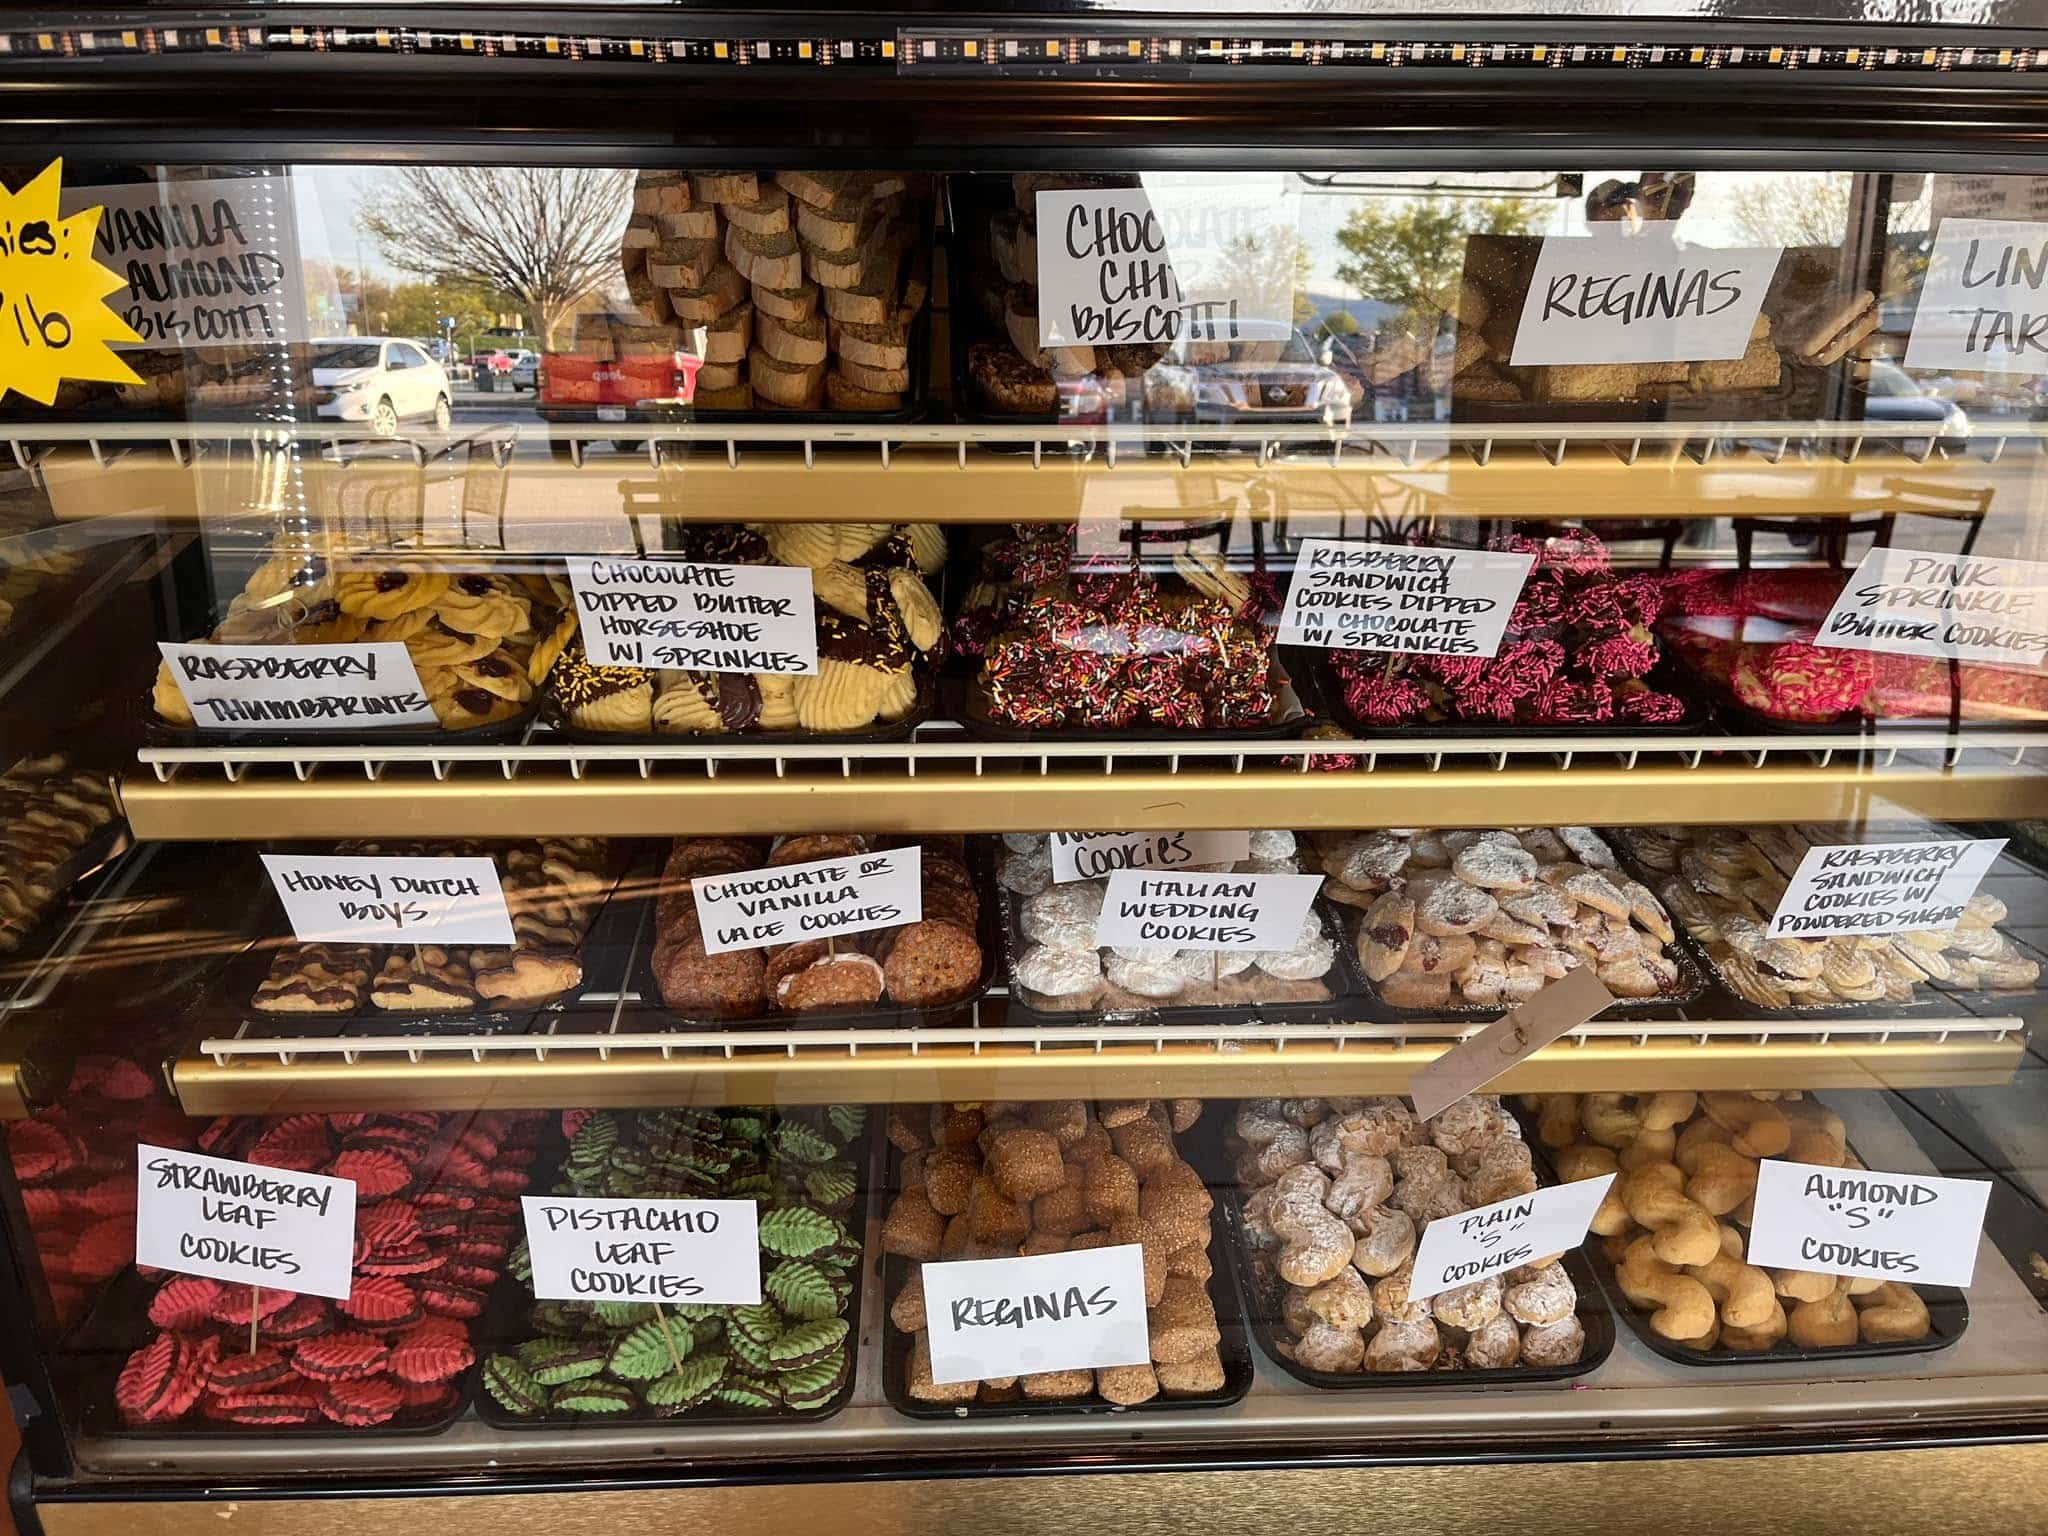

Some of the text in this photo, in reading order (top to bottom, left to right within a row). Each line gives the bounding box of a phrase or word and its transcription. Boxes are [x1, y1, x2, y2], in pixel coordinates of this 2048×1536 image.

[126, 253, 285, 301] ALMOND
[1542, 267, 1741, 325] REGINAS
[1071, 300, 1239, 341] BISCOTTI
[591, 561, 736, 588] CHOCOLATE
[1309, 572, 1451, 593] SANDWICH
[1903, 558, 1998, 587] PINK
[579, 591, 796, 617] DIPPED BUTTER
[1295, 588, 1496, 615] COOKIES DIPPED
[1855, 584, 2033, 614] SPRINKLE
[600, 616, 762, 642] HORSESHOE
[1295, 611, 1476, 635] IN CHOCOLATE
[1830, 612, 2048, 651] BUTTER COOKIES
[1342, 632, 1479, 653] SPRINKLES
[178, 652, 376, 681] RASPBERRY
[653, 646, 809, 672] SPRINKLES
[193, 692, 431, 722] THUMBPRINTS
[1075, 837, 1192, 878] Cookies
[1820, 842, 1974, 870] RASPBERRY
[281, 870, 480, 899] HONEY DUTCH
[703, 858, 893, 902] CHOCOLATE OR
[1140, 880, 1256, 898] ITALIAN
[1810, 864, 1947, 890] SANDWICH
[737, 885, 860, 917] VANILLA
[1120, 901, 1259, 921] WEDDING
[1803, 889, 1898, 912] COOKIES
[717, 904, 901, 945] LACE COOKIES
[1140, 922, 1256, 943] COOKIES
[1777, 905, 1966, 932] POWDERED SUGAR
[147, 1158, 332, 1217] STRAWBERRY
[1804, 1174, 1938, 1206] ALMOND
[202, 1196, 277, 1230] LEAF
[540, 1206, 720, 1234] PISTACHIO
[1459, 1198, 1535, 1234] PLAIN
[180, 1232, 301, 1275] COOKIES
[594, 1240, 676, 1266] LEAF
[1442, 1243, 1533, 1284] COOKIES
[1801, 1236, 1920, 1273] COOKIES
[570, 1267, 705, 1298] COOKIES
[951, 1285, 1118, 1332] REGINAS
